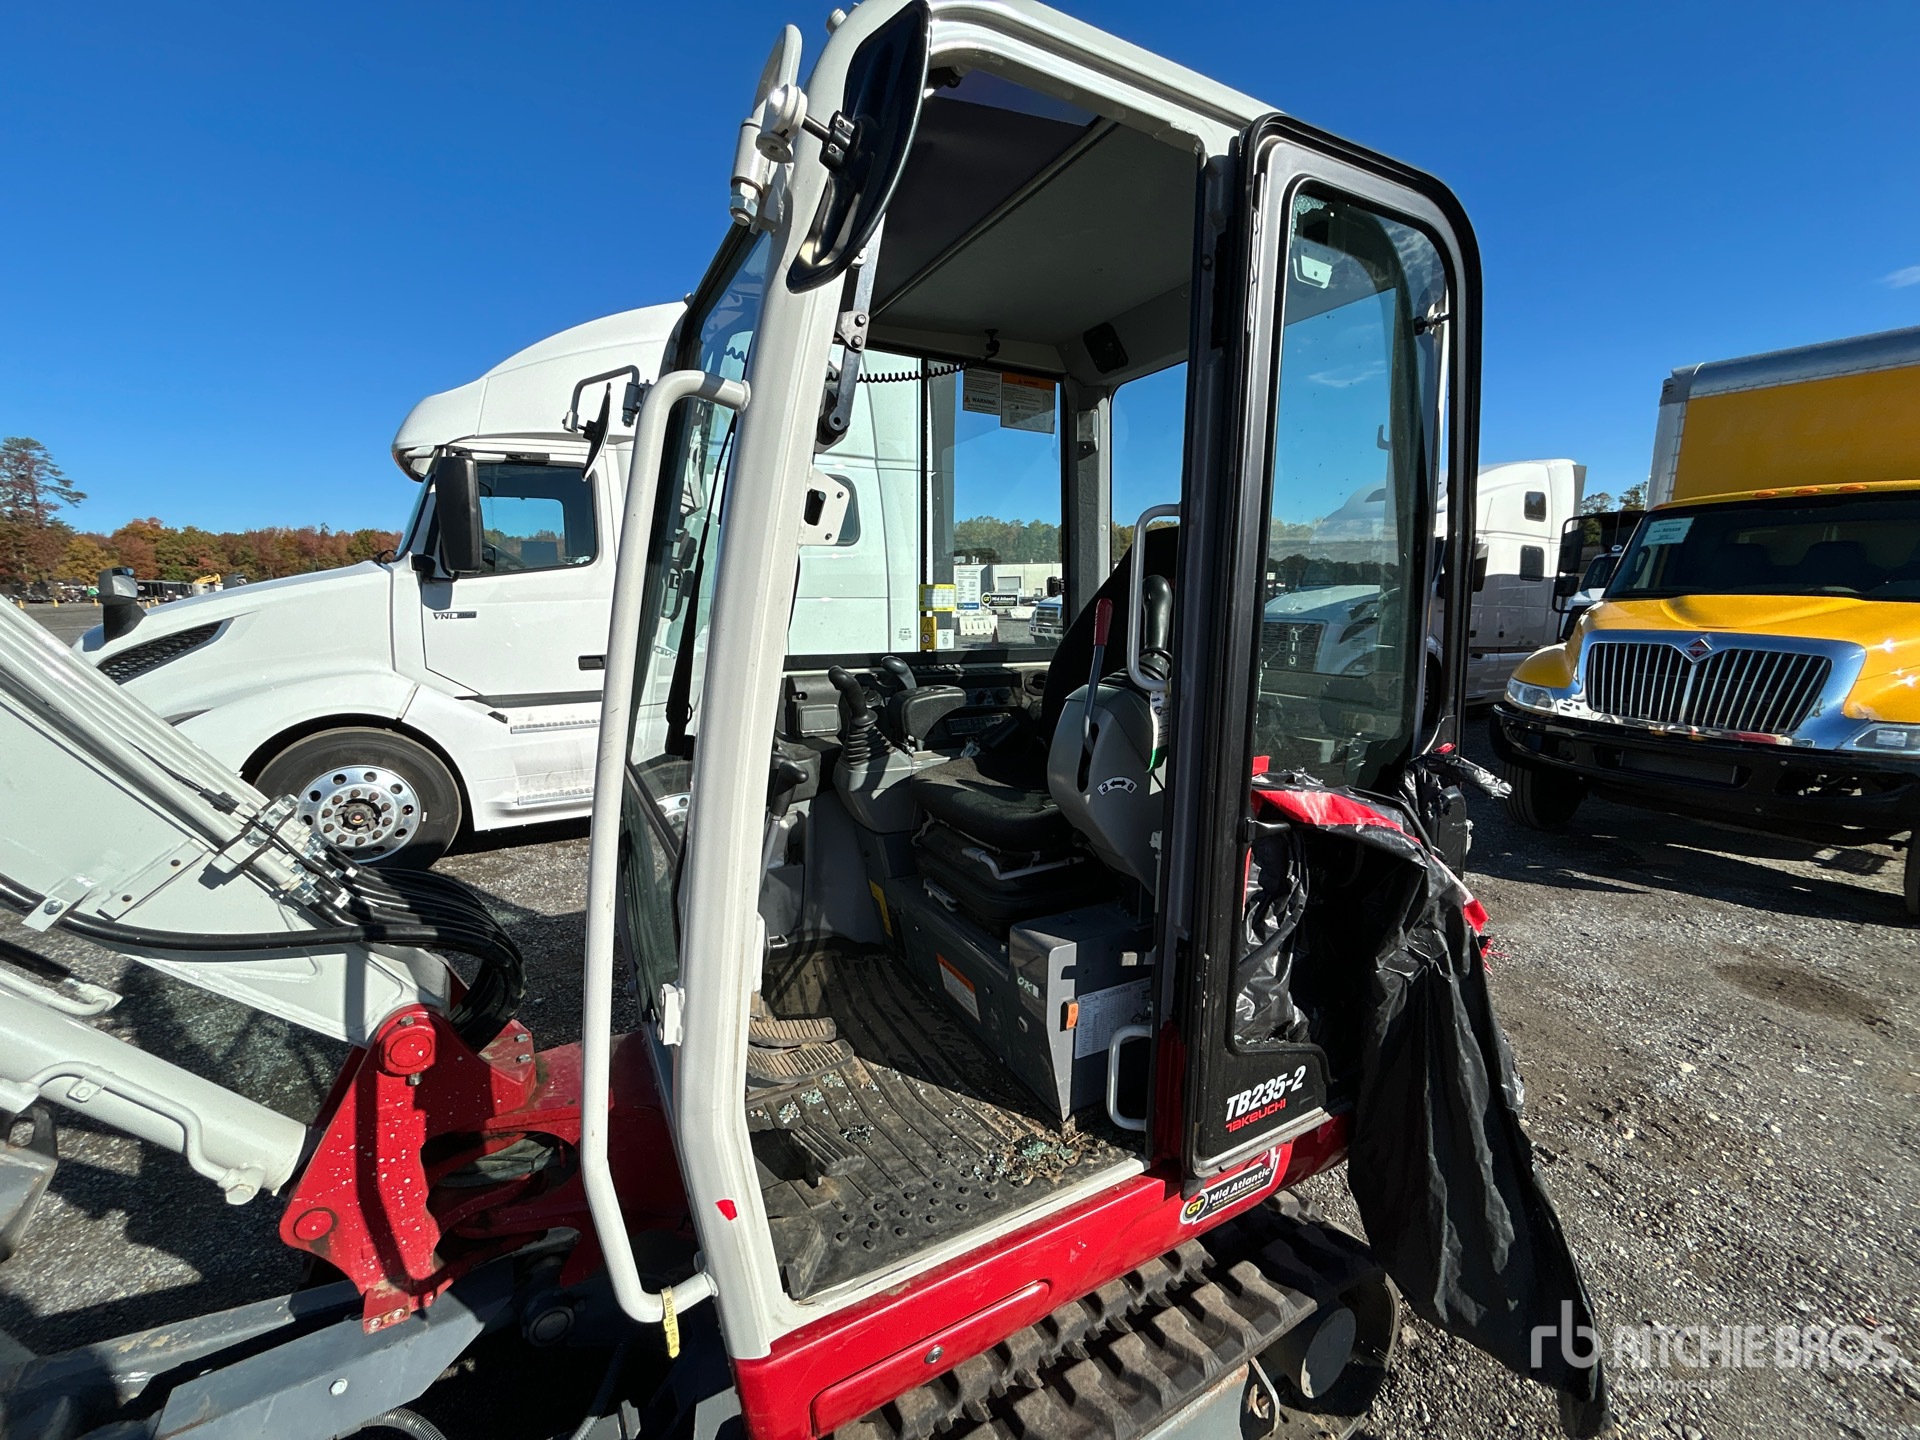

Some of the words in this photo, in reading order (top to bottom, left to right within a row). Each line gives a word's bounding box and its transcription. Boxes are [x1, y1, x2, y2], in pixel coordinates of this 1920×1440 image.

[972, 397, 996, 406] WARNING
[1225, 1065, 1306, 1121] TB235-2
[1187, 1199, 1205, 1214] GT
[1209, 1184, 1229, 1204] Mid
[1231, 1166, 1271, 1193] Atlantic
